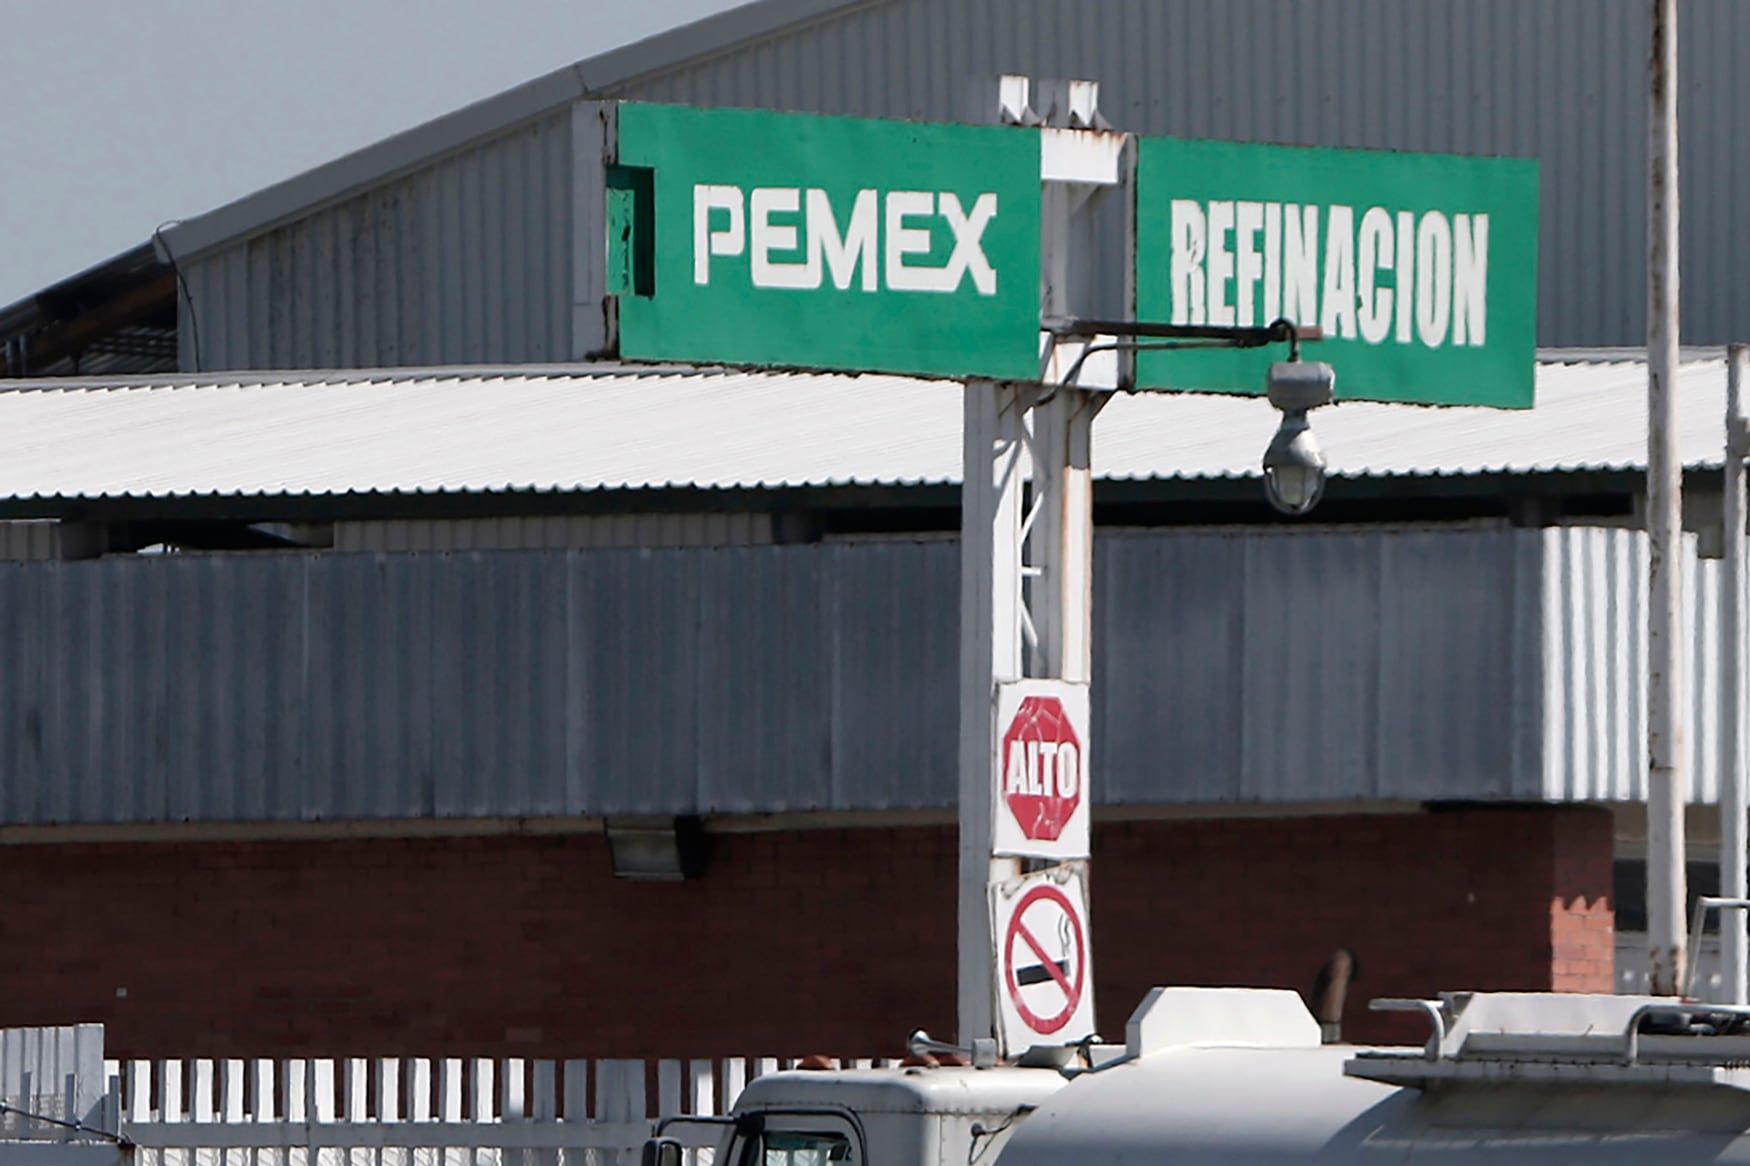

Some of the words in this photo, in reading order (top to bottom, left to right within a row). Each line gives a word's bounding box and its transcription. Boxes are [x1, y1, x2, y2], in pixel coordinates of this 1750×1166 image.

[692, 183, 998, 297] PEMEX
[1169, 199, 1491, 348] REFINACION
[1007, 740, 1078, 800] ALTO
